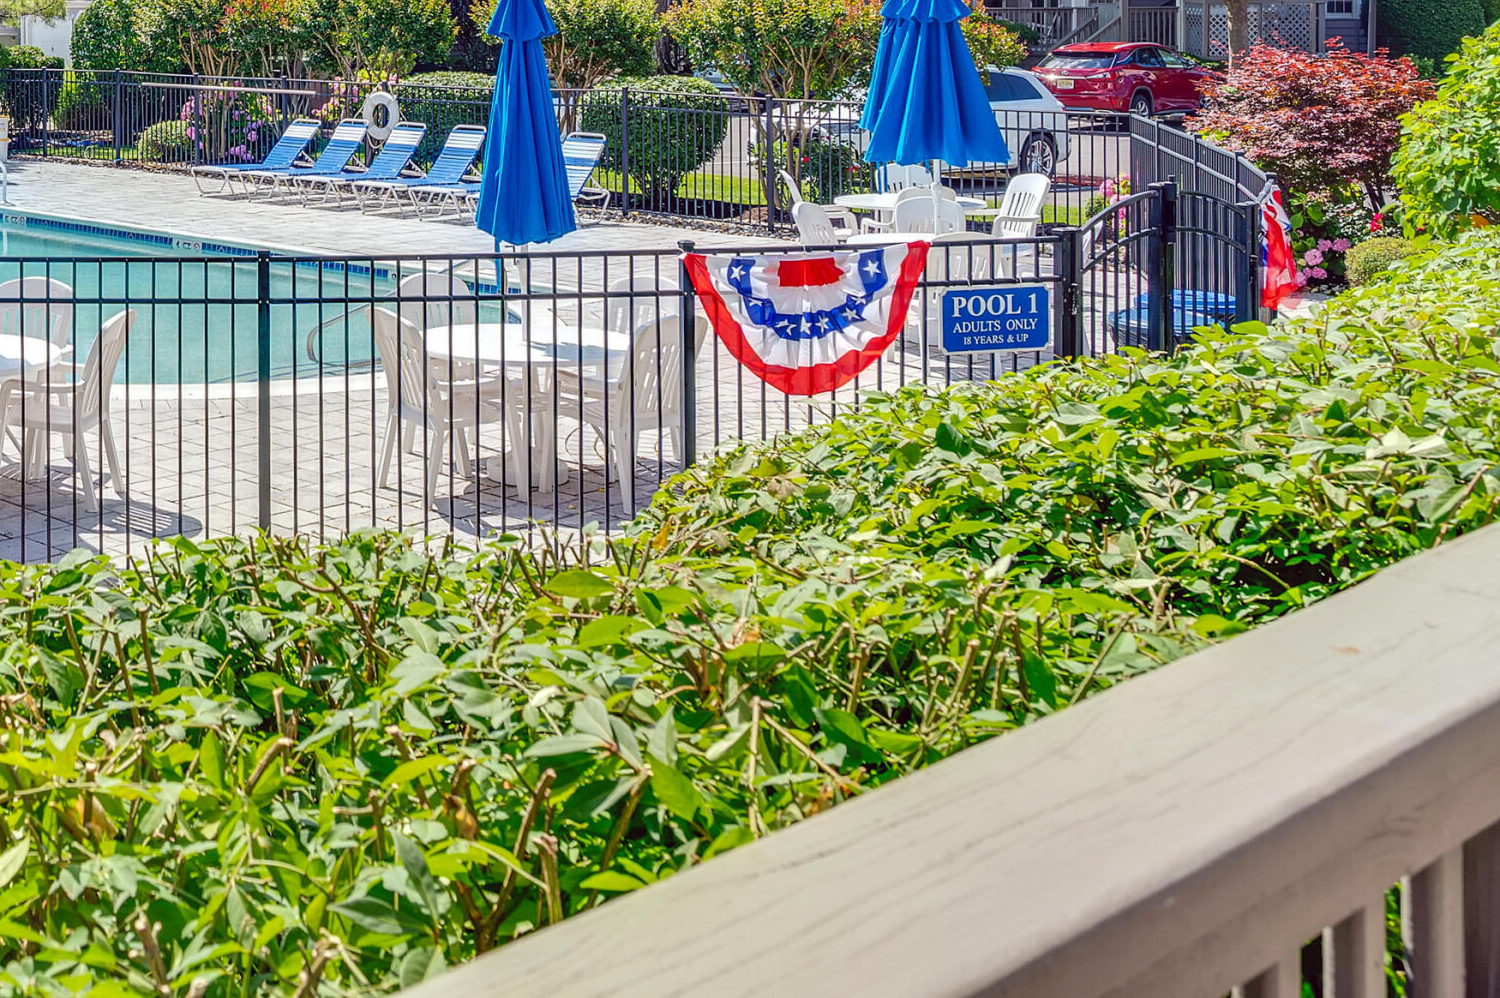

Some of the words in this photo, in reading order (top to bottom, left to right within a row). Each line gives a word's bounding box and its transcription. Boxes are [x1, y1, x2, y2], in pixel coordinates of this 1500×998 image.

[952, 294, 1021, 317] POOL
[1028, 292, 1038, 313] 1
[953, 320, 1001, 334] ADULTS
[1006, 318, 1038, 331] ONLY
[963, 336, 972, 345] 18
[973, 334, 1004, 344] YEARS
[1007, 334, 1014, 343] &
[1016, 333, 1029, 343] UP
